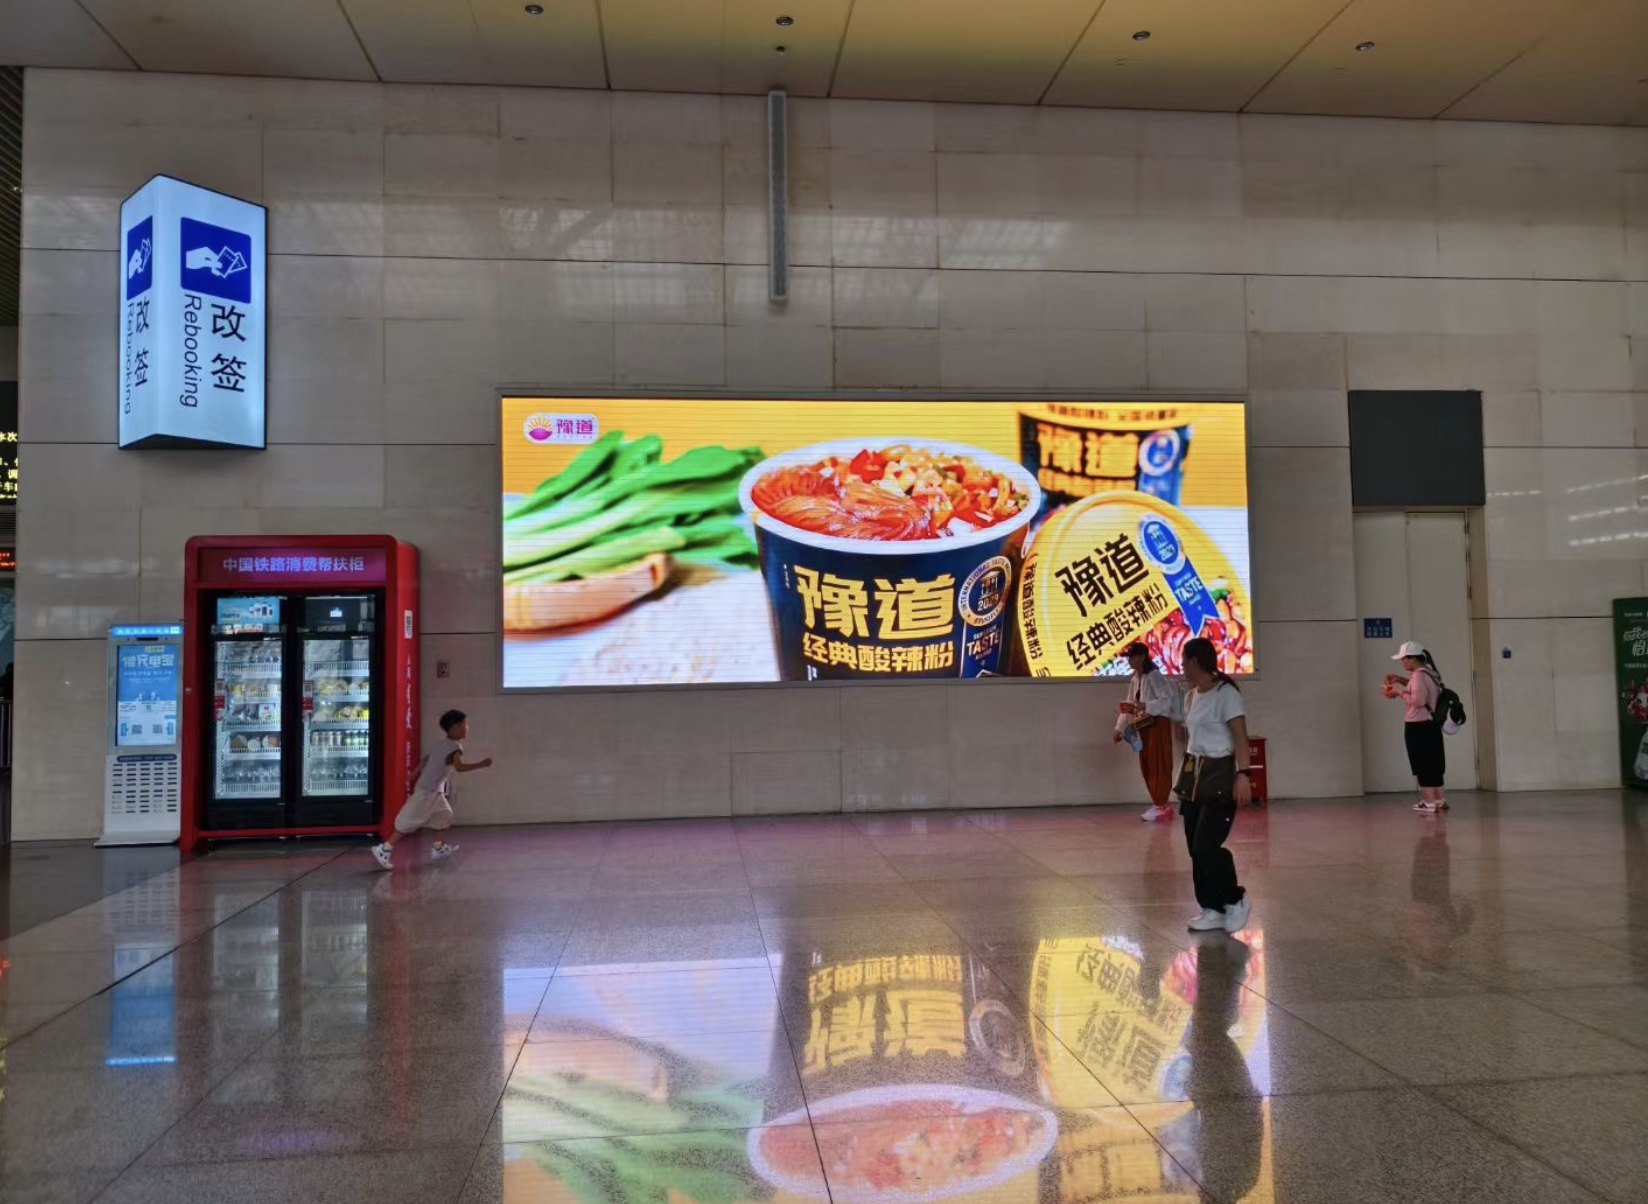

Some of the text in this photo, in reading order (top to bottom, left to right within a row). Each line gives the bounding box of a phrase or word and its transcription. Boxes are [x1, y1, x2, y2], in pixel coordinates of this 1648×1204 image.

[125, 302, 135, 414] Rebooking
[135, 296, 150, 387] 改签
[179, 293, 202, 407] Rebooking
[211, 303, 247, 392] 改签
[556, 419, 594, 435] 豫道
[222, 556, 365, 572] 中国铁路消费帮扶柜
[794, 565, 956, 640] 豫道
[1055, 532, 1150, 618] 豫道
[1175, 577, 1203, 602] TASTE
[803, 632, 954, 673] 经典酸辣粉
[967, 632, 1000, 656] TASTE
[1066, 583, 1169, 671] 经典酸辣粉
